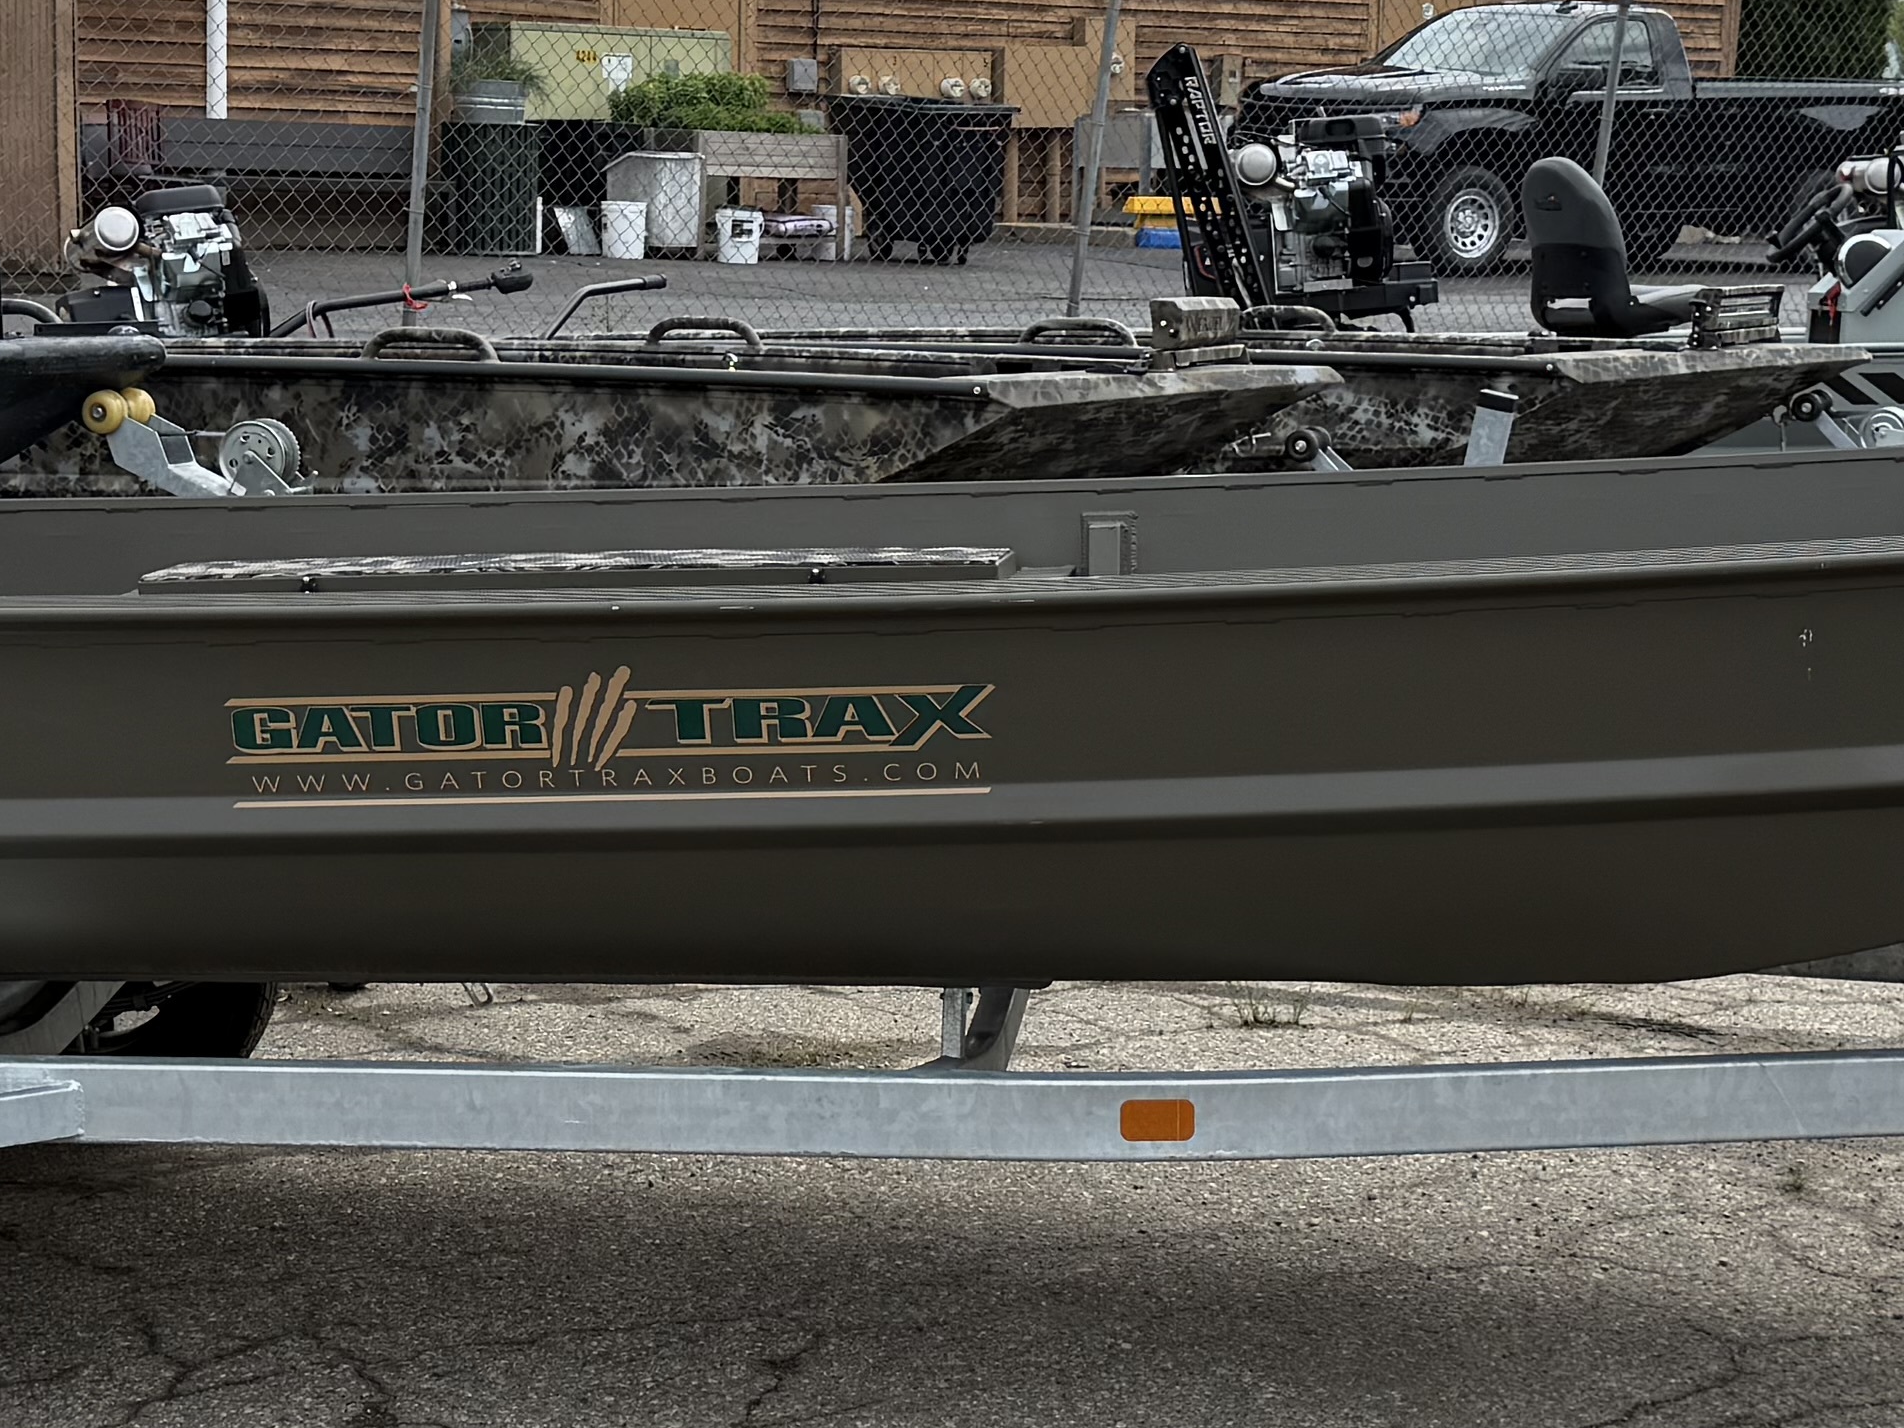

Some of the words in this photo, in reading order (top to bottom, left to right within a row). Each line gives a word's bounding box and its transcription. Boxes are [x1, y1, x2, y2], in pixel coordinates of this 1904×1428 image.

[1183, 75, 1217, 145] RAPTOR
[230, 702, 549, 755] GATOR
[645, 684, 995, 747] TRAX
[252, 761, 981, 793] WWW.GATORTRAXBOATS.COM
